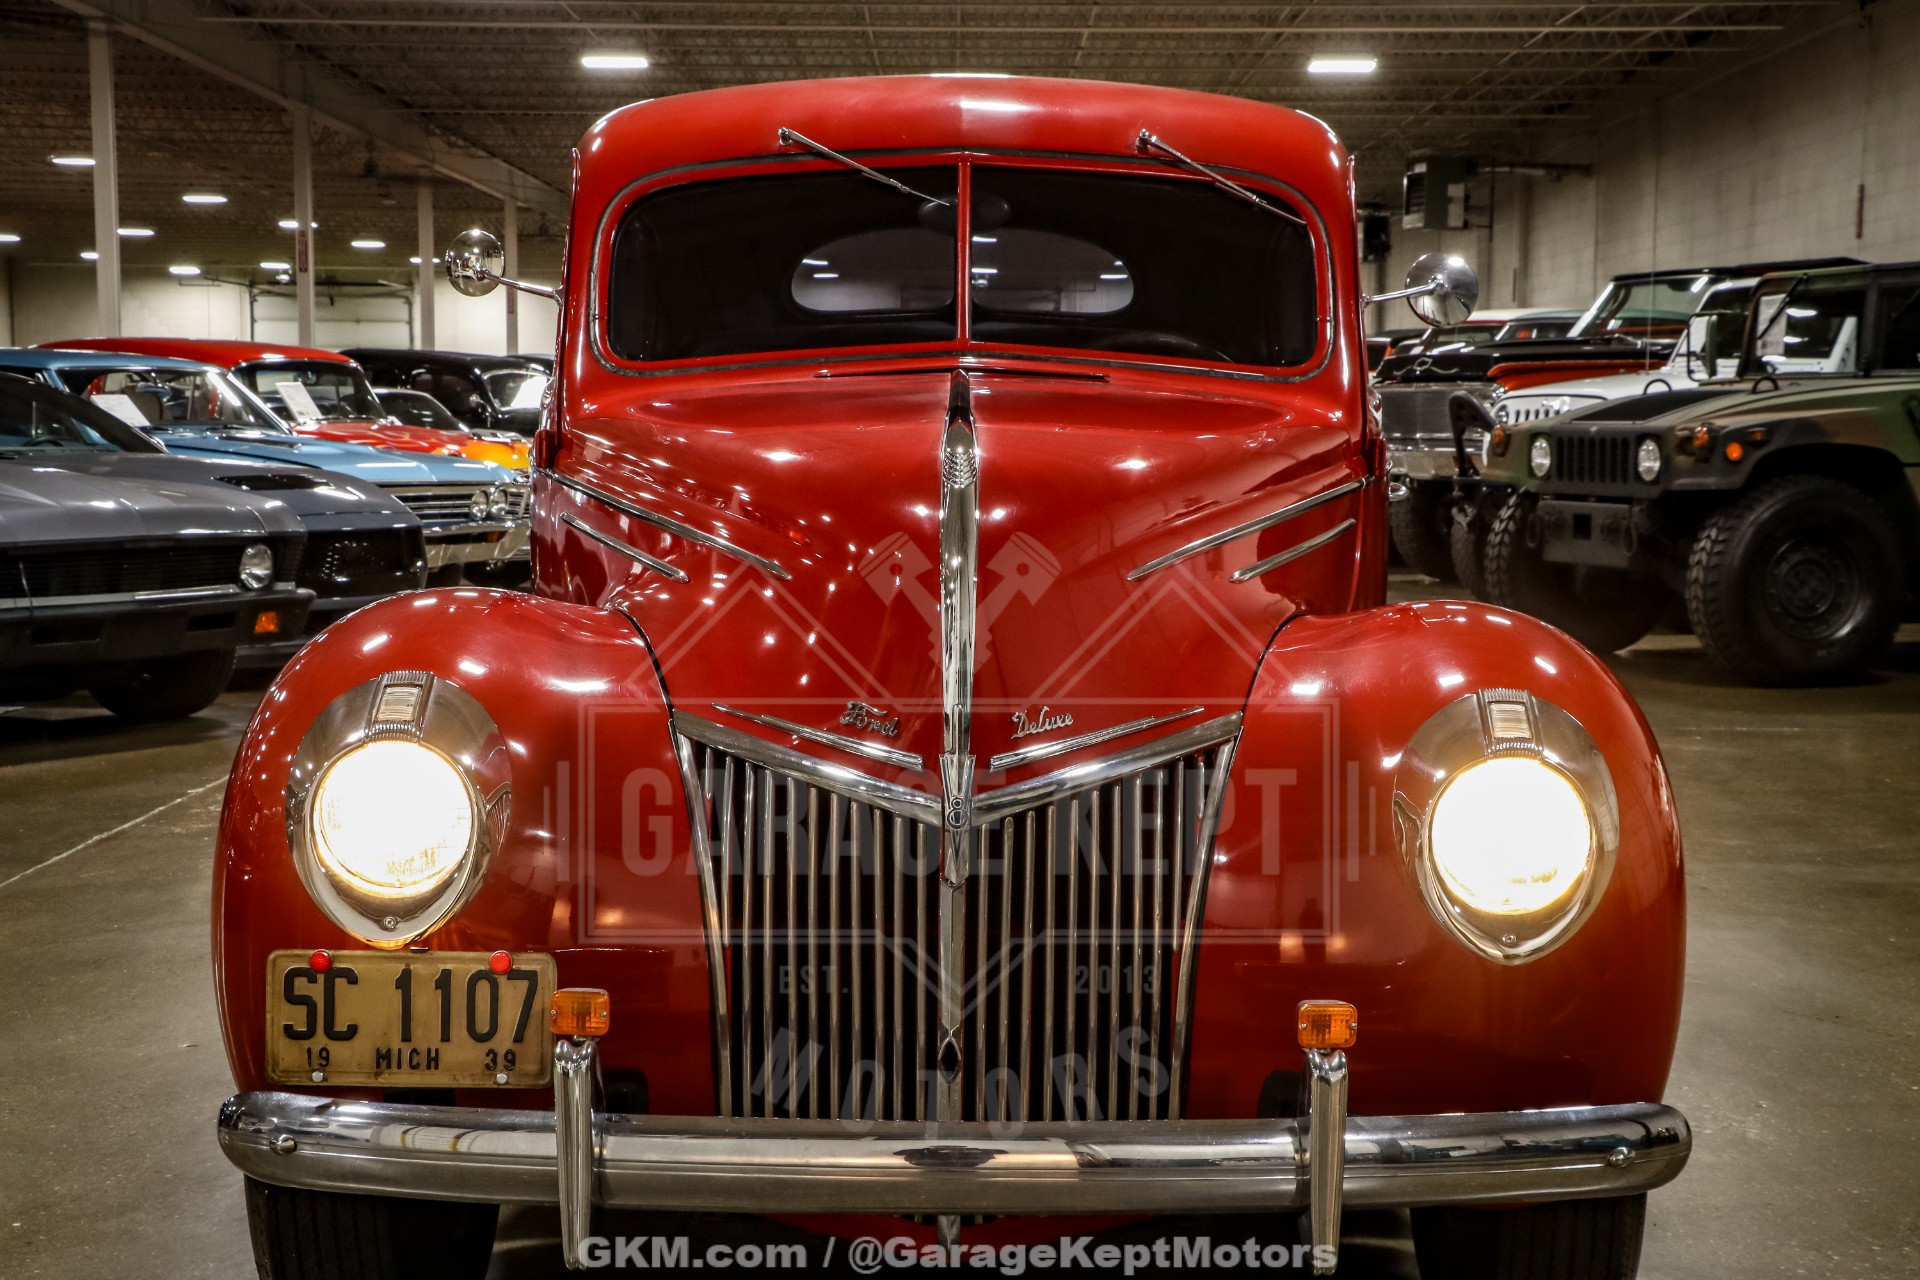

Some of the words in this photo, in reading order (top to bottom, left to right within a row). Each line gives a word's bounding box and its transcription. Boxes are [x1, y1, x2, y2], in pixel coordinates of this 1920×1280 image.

[839, 700, 899, 737] Ford
[283, 966, 359, 1041] SC
[395, 967, 539, 1043] 1107
[306, 1047, 330, 1069] 19
[374, 1048, 440, 1070] MICH
[484, 1049, 517, 1071] 39
